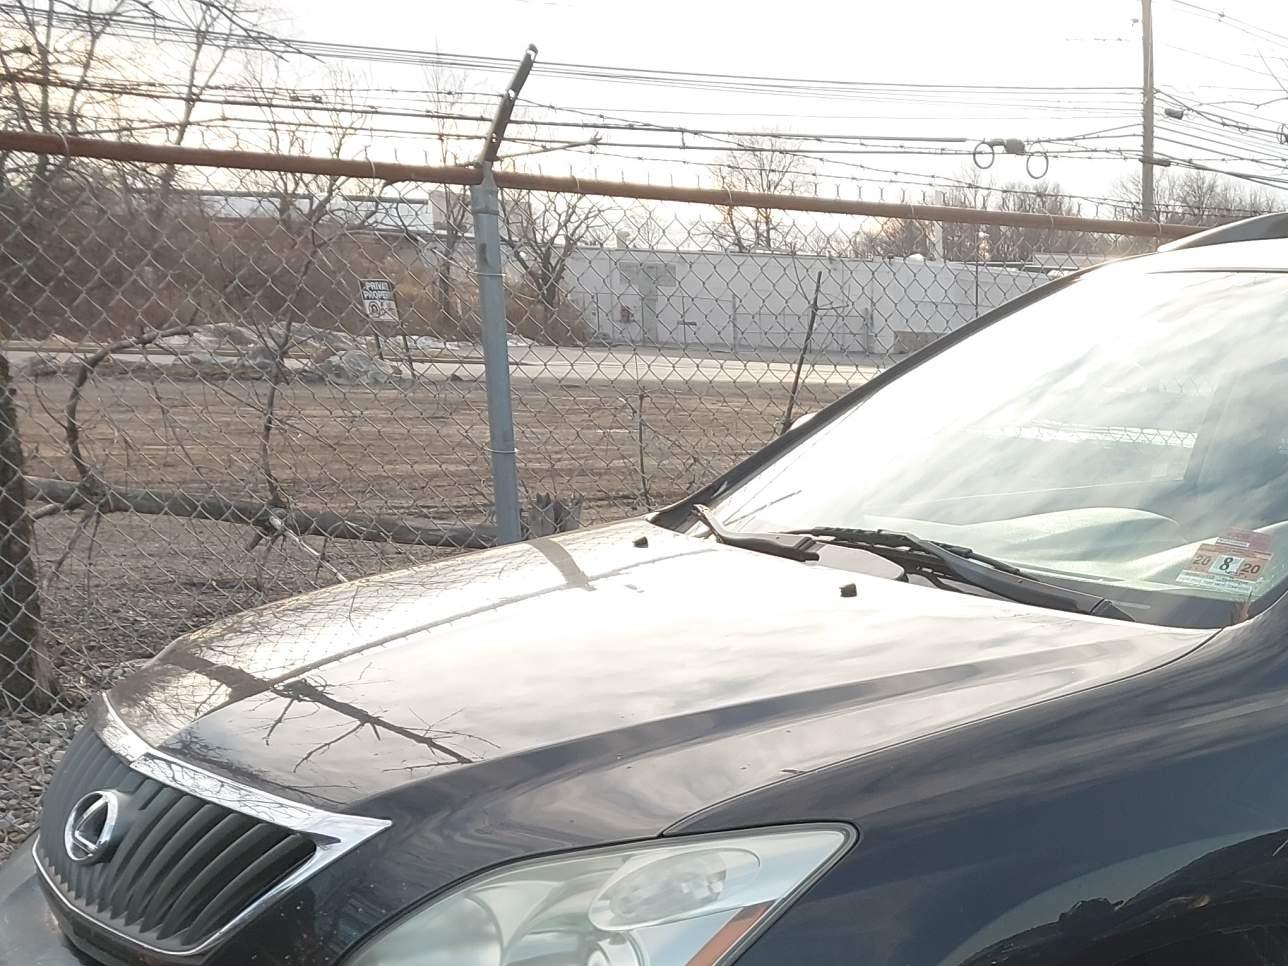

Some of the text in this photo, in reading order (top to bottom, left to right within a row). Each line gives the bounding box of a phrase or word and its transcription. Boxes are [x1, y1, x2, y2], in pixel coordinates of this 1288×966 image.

[362, 290, 394, 301] PROPE
[1192, 554, 1262, 575] 20 8 20
